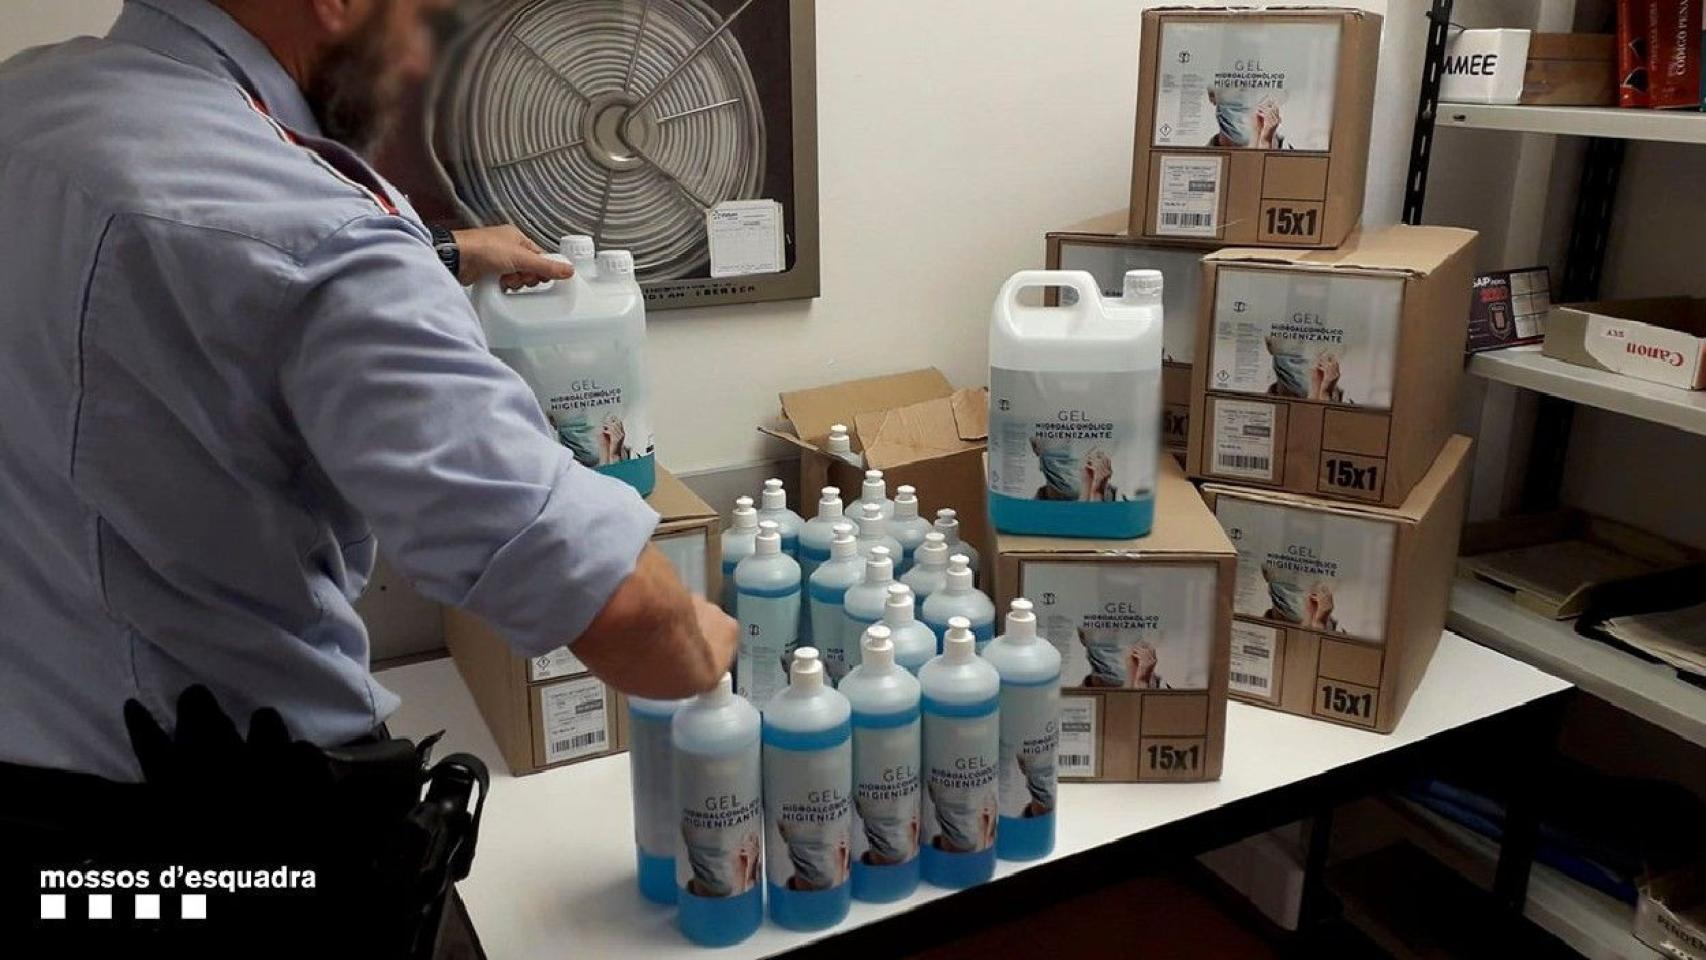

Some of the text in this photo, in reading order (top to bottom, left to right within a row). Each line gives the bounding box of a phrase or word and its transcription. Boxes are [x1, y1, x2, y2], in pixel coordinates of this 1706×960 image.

[1234, 60, 1264, 72] GEL
[1214, 80, 1285, 89] HIGIENIZANTE
[1265, 207, 1318, 236] 15x1
[1293, 312, 1323, 326] GEL
[1270, 331, 1344, 344] HIGIENIZANTE
[1627, 341, 1685, 367] Canon
[571, 379, 602, 391] GEL
[551, 396, 621, 410] HIGIENIZANTE
[1057, 409, 1090, 422] GEL
[1035, 431, 1113, 439] HIGIENIZANTE
[1326, 458, 1377, 491] 15x1
[1287, 543, 1317, 559] GEL
[1266, 559, 1337, 577] HIGIENIZANTE
[1105, 602, 1136, 614] GEL
[1083, 621, 1159, 630] HIGIENIZANTE
[1321, 685, 1372, 718] 15x1
[954, 754, 988, 770] GEL
[1147, 744, 1200, 771] 15x1
[882, 764, 916, 781] GEL
[705, 795, 740, 811] GEL
[808, 787, 842, 803] GEL
